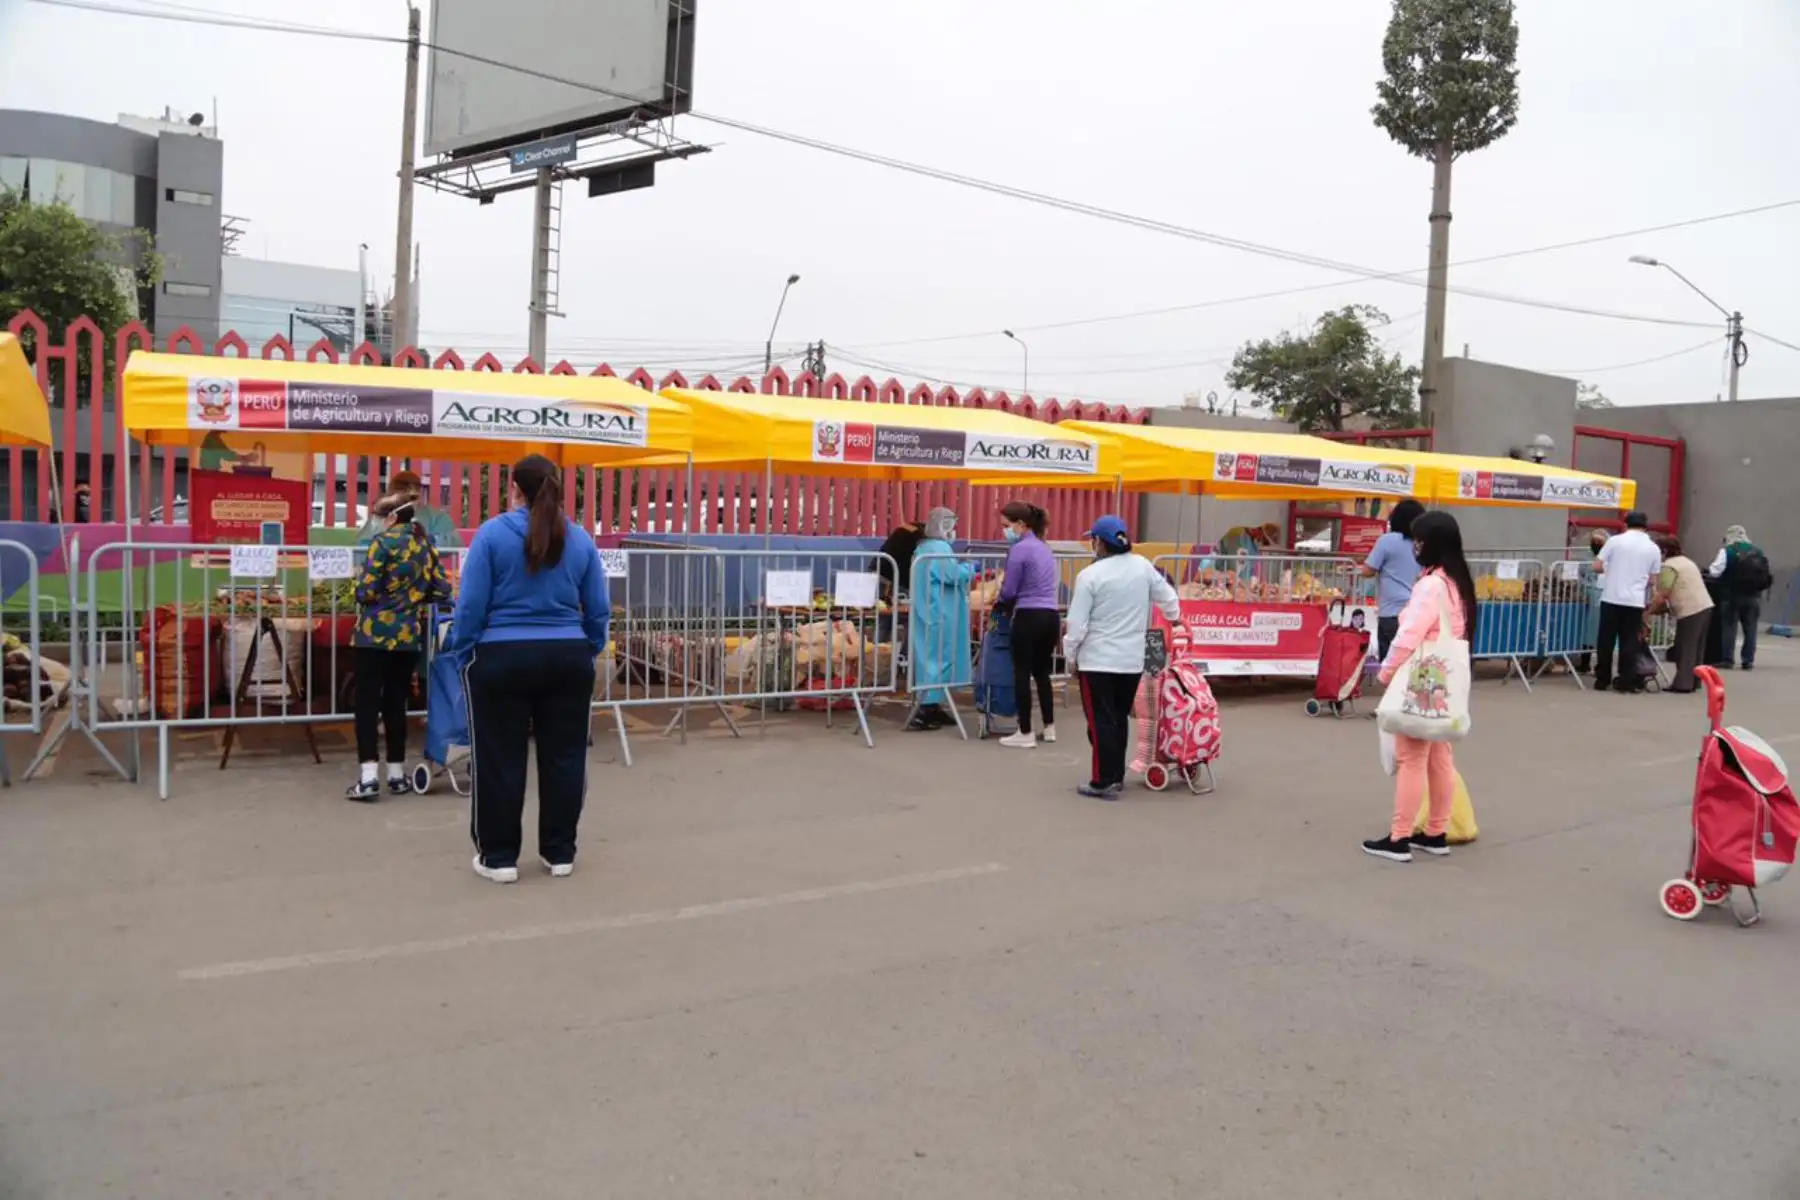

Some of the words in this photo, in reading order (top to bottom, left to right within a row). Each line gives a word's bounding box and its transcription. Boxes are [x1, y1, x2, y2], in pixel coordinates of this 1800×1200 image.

[243, 392, 282, 410] PERÚ
[292, 389, 359, 407] Ministerio
[292, 407, 311, 420] de
[312, 406, 383, 424] Agricultura
[384, 411, 392, 425] y
[395, 411, 429, 427] Riego
[847, 431, 871, 448] PERÚ
[878, 430, 921, 444] Ministerio
[877, 443, 888, 456] de
[889, 444, 933, 459] Agricultura
[934, 450, 940, 460] y
[941, 447, 963, 462] Riego
[1219, 614, 1226, 626] A
